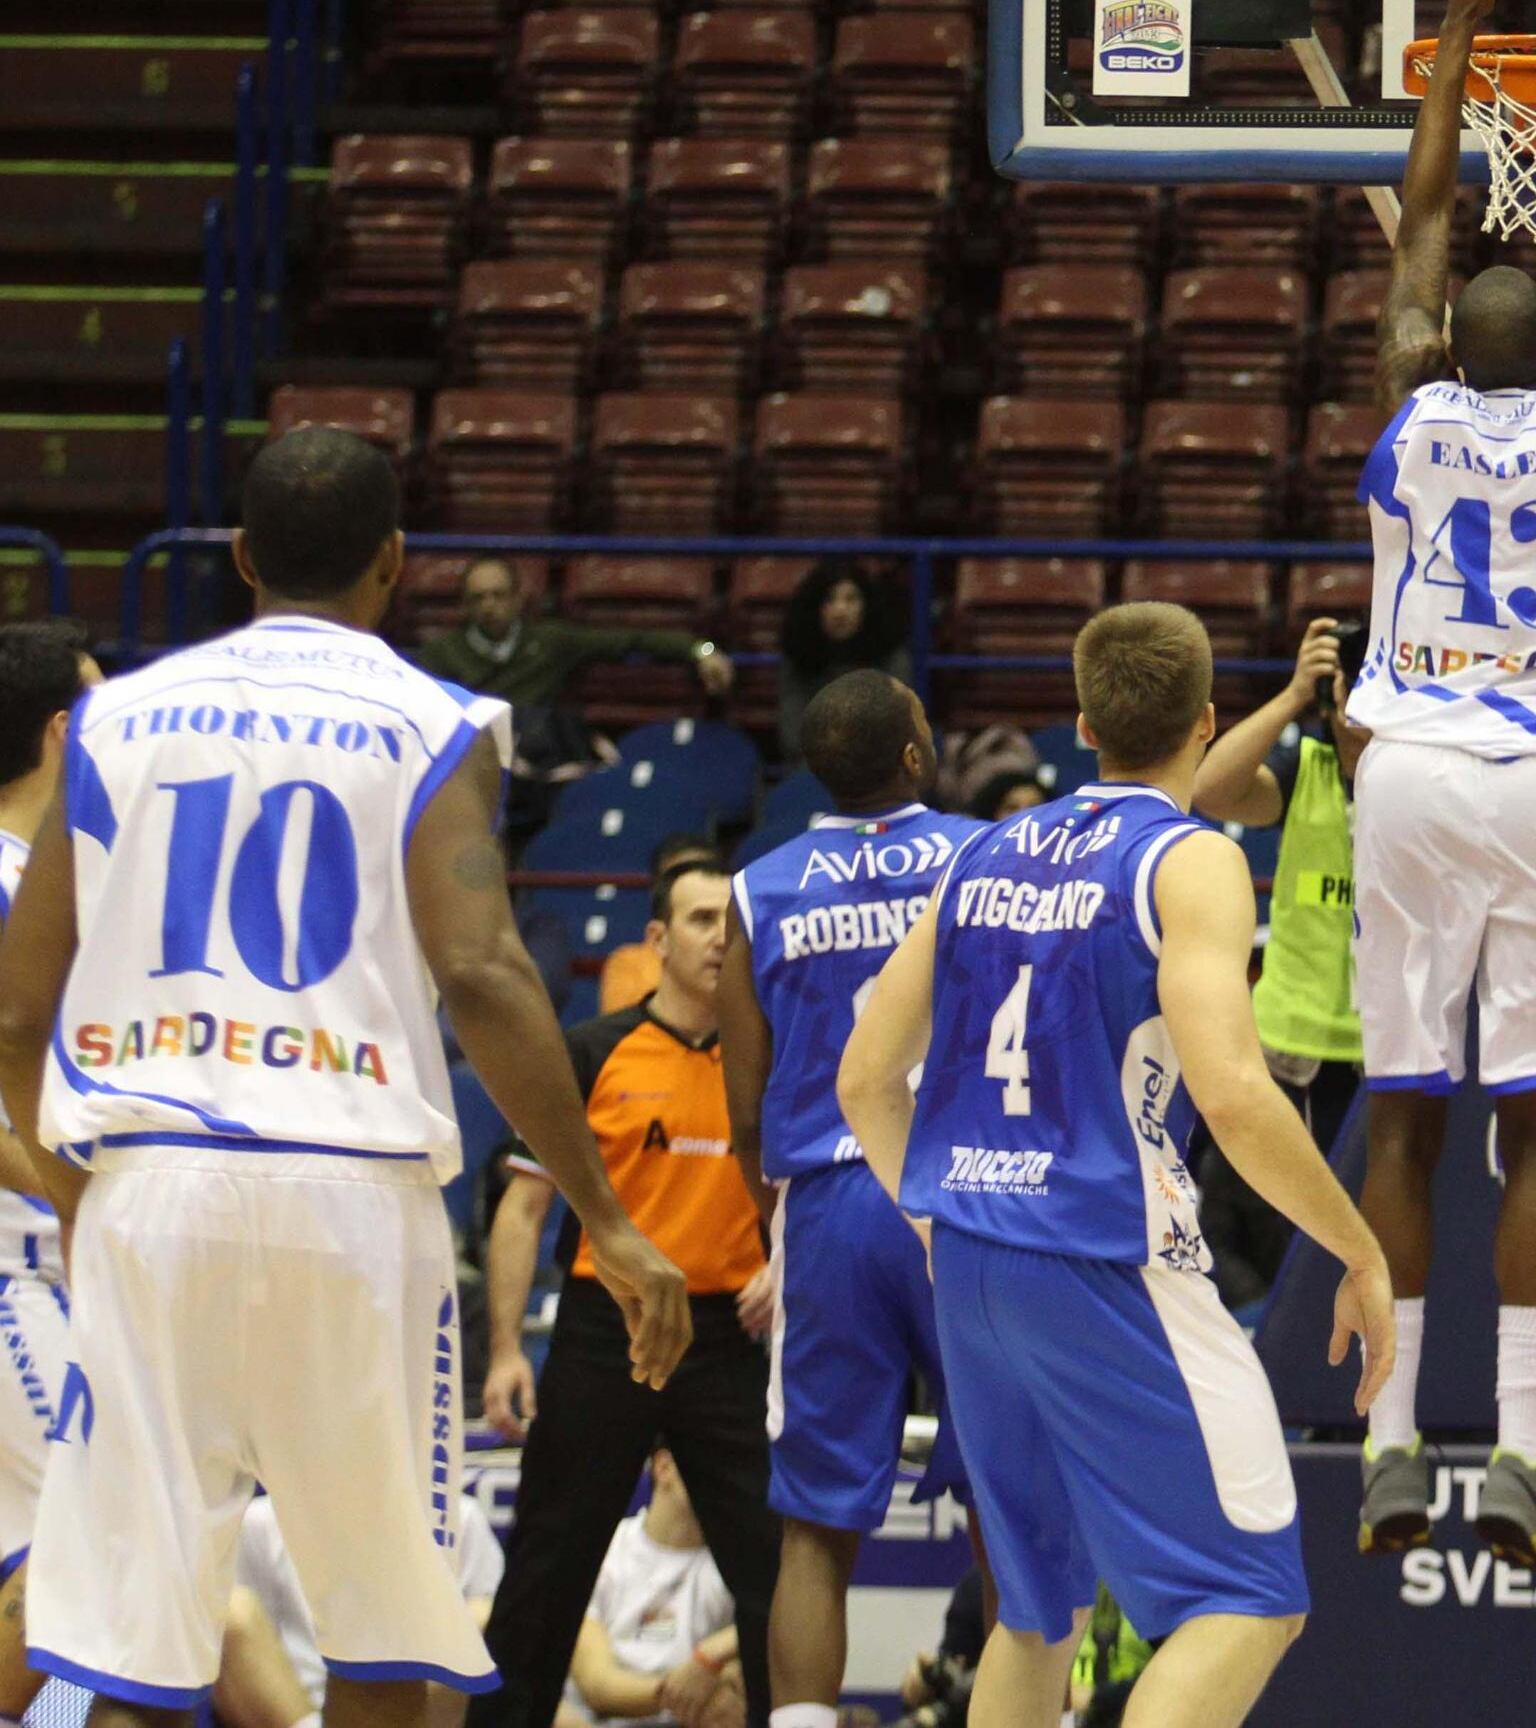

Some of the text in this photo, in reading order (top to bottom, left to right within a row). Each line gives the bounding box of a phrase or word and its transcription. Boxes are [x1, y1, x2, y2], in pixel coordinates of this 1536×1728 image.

[1108, 55, 1175, 69] BEKO
[117, 703, 407, 765] THORNTON
[148, 773, 360, 993] 10
[1320, 875, 1355, 905] PH
[778, 895, 931, 962] ROBINS
[75, 1010, 390, 1087] SARDEGNA
[983, 963, 1034, 1117] 4
[1137, 1055, 1165, 1151] Enel
